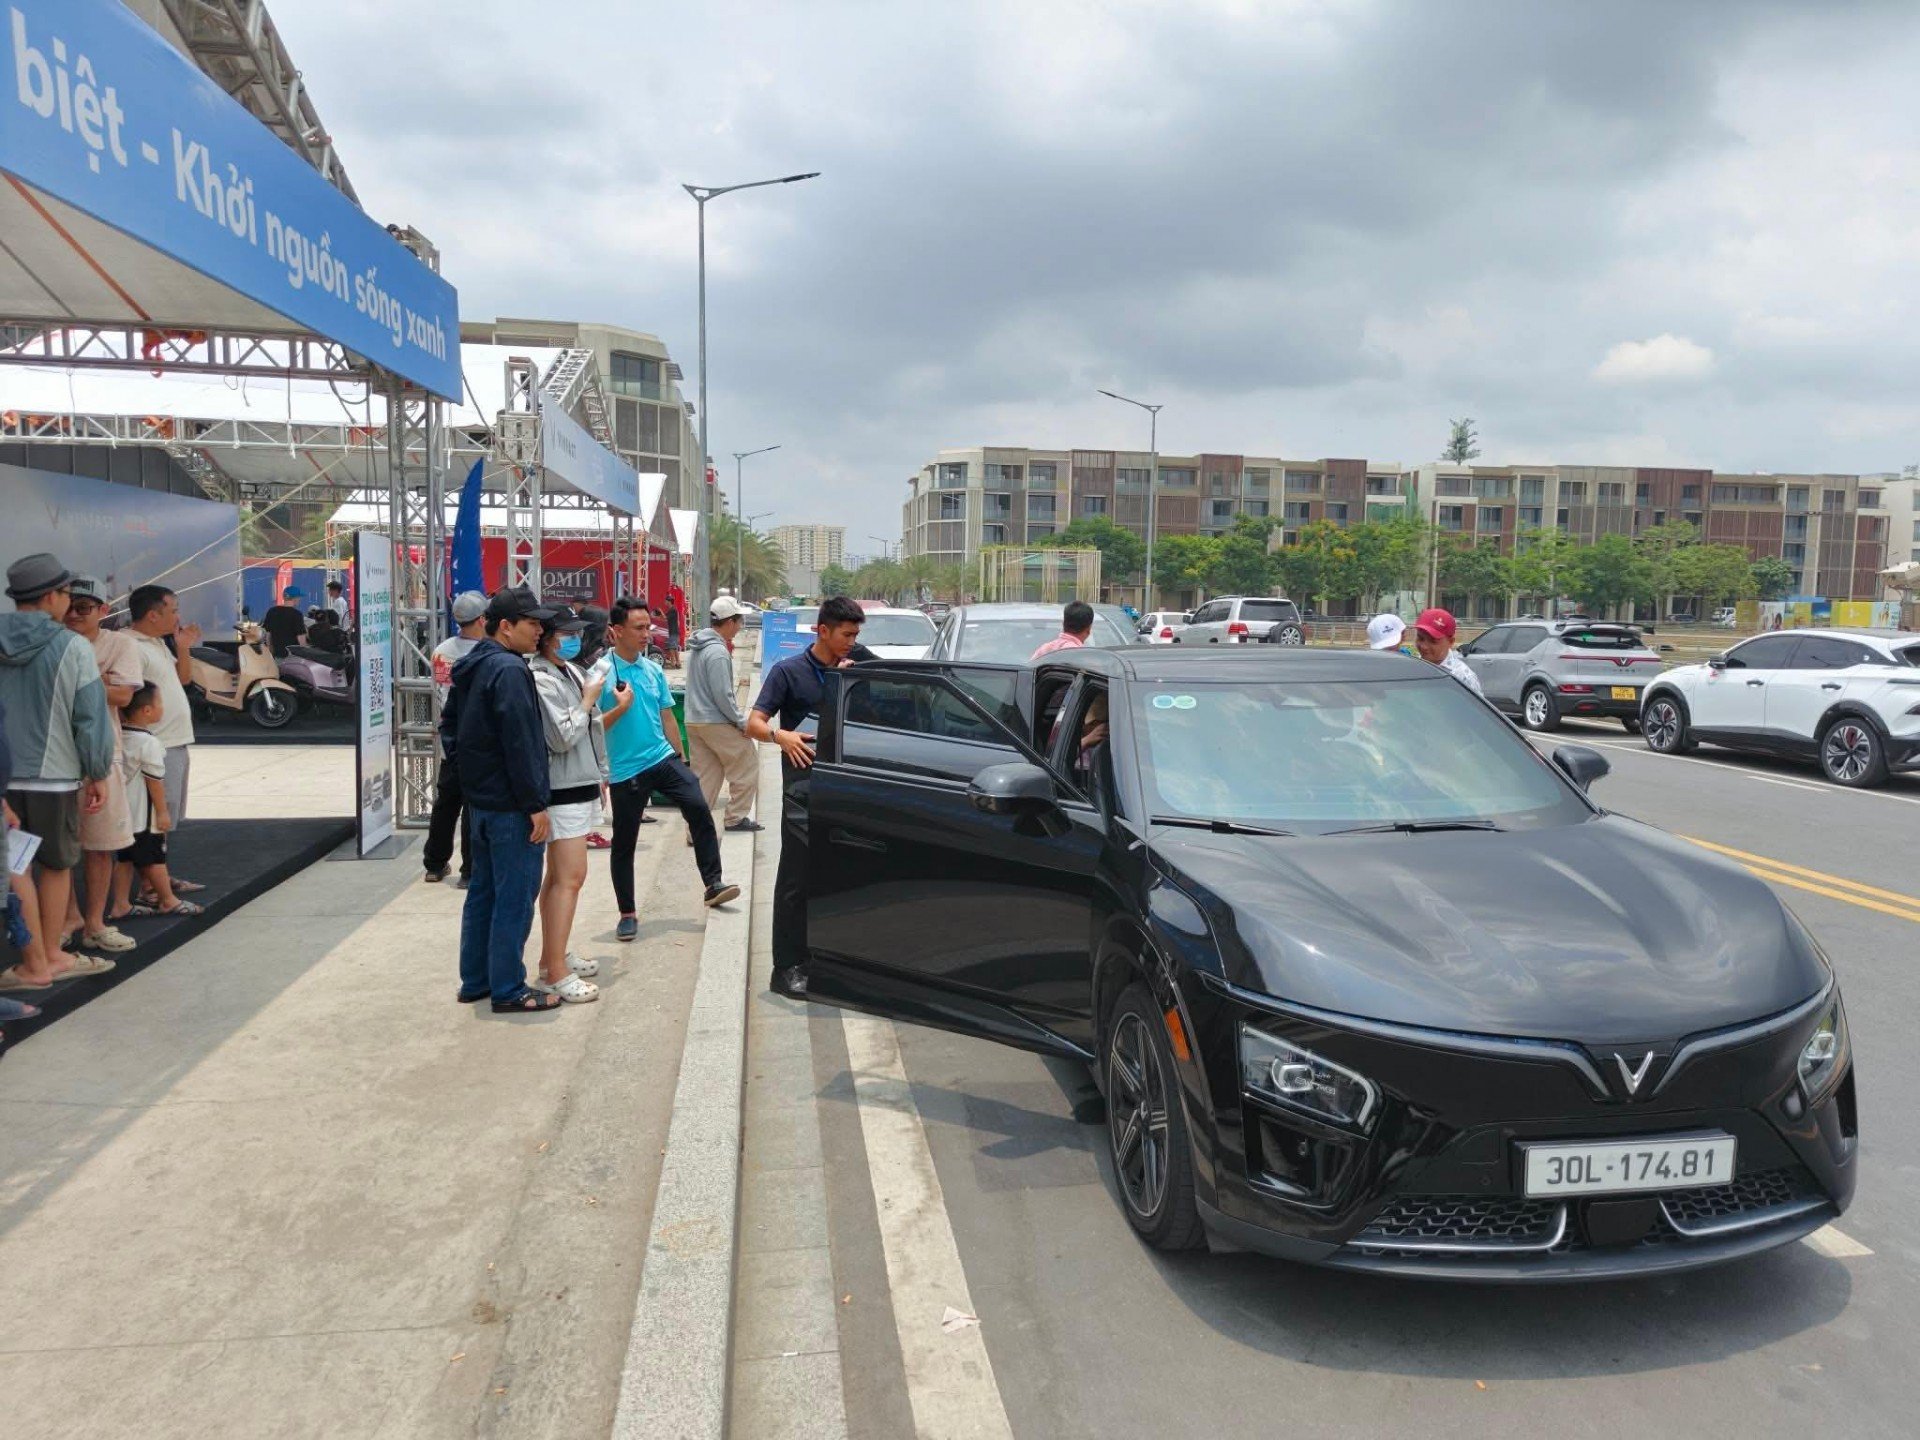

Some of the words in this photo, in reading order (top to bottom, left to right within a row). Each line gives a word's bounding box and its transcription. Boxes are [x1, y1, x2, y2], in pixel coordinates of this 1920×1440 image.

[11, 7, 128, 174] biệt
[172, 127, 257, 246] Khởi
[266, 210, 349, 304] nguồn
[354, 266, 402, 348] sống
[405, 314, 446, 362] xanh
[1546, 1148, 1715, 1185] 30L-174.81
